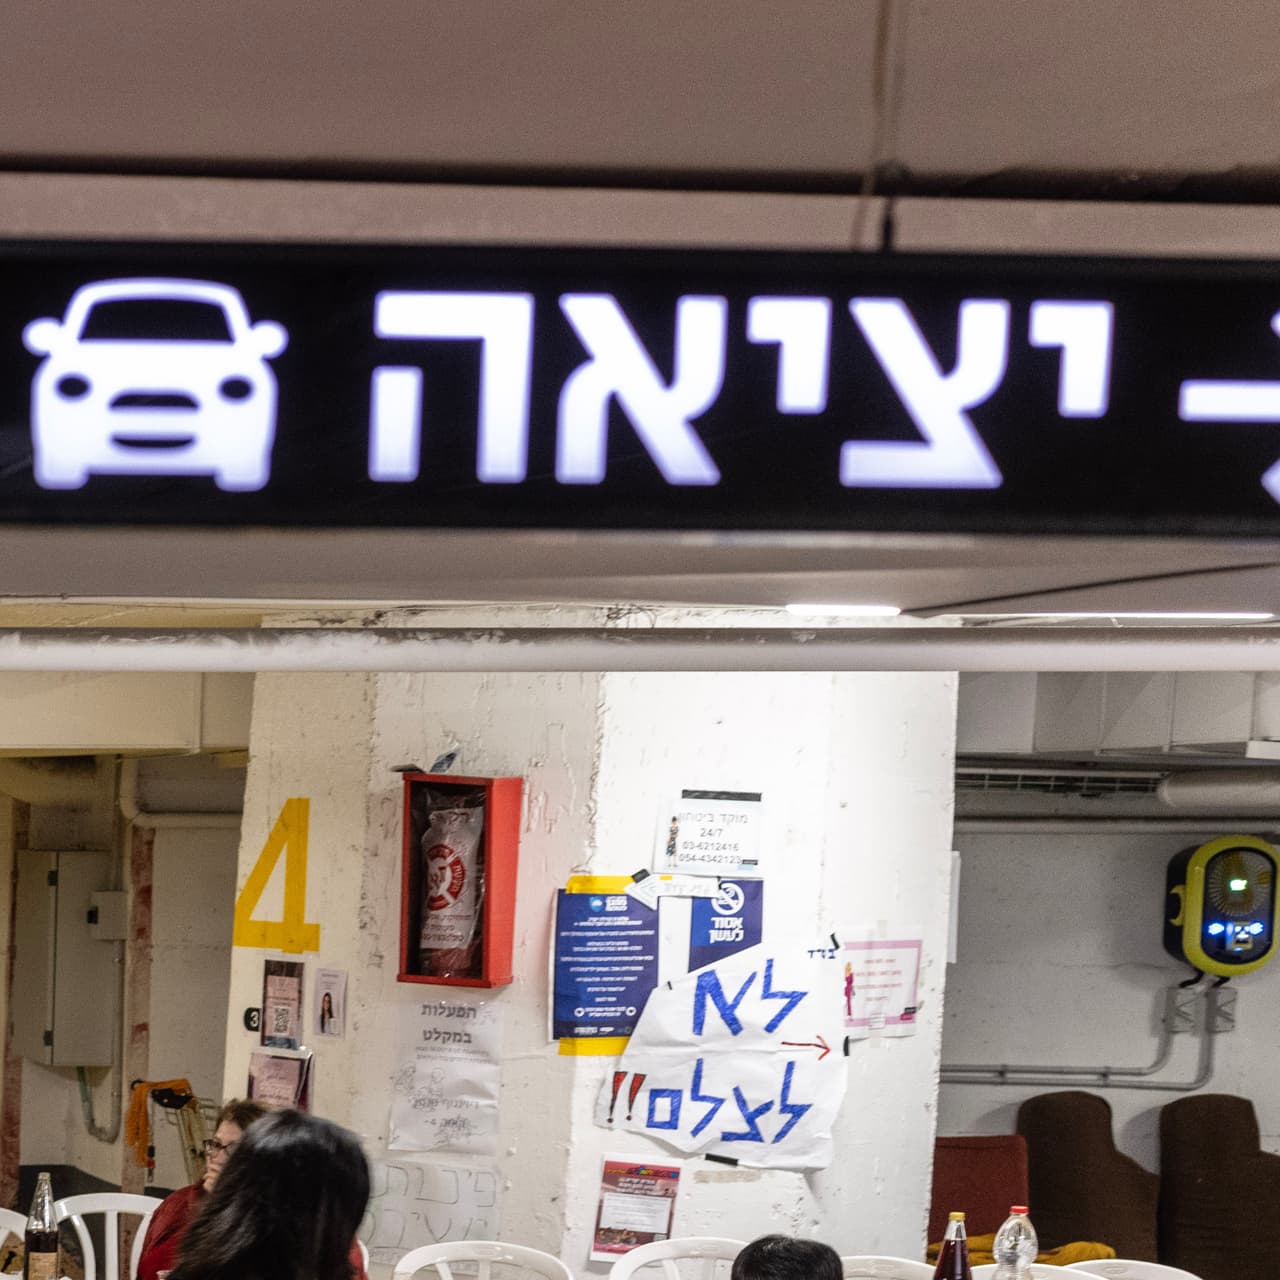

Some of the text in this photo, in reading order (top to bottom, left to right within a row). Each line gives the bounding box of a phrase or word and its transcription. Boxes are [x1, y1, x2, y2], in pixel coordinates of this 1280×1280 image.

[369, 291, 1115, 488] יציאה
[720, 812, 749, 825] מוקד
[700, 827, 724, 838] 24/7
[232, 797, 320, 954] 4
[710, 916, 744, 932] אסור
[709, 929, 744, 944] לעשן
[692, 958, 808, 1037] לא
[421, 1001, 477, 1019] הפעלות
[249, 1010, 260, 1028] 3
[423, 1027, 473, 1044] במקלט
